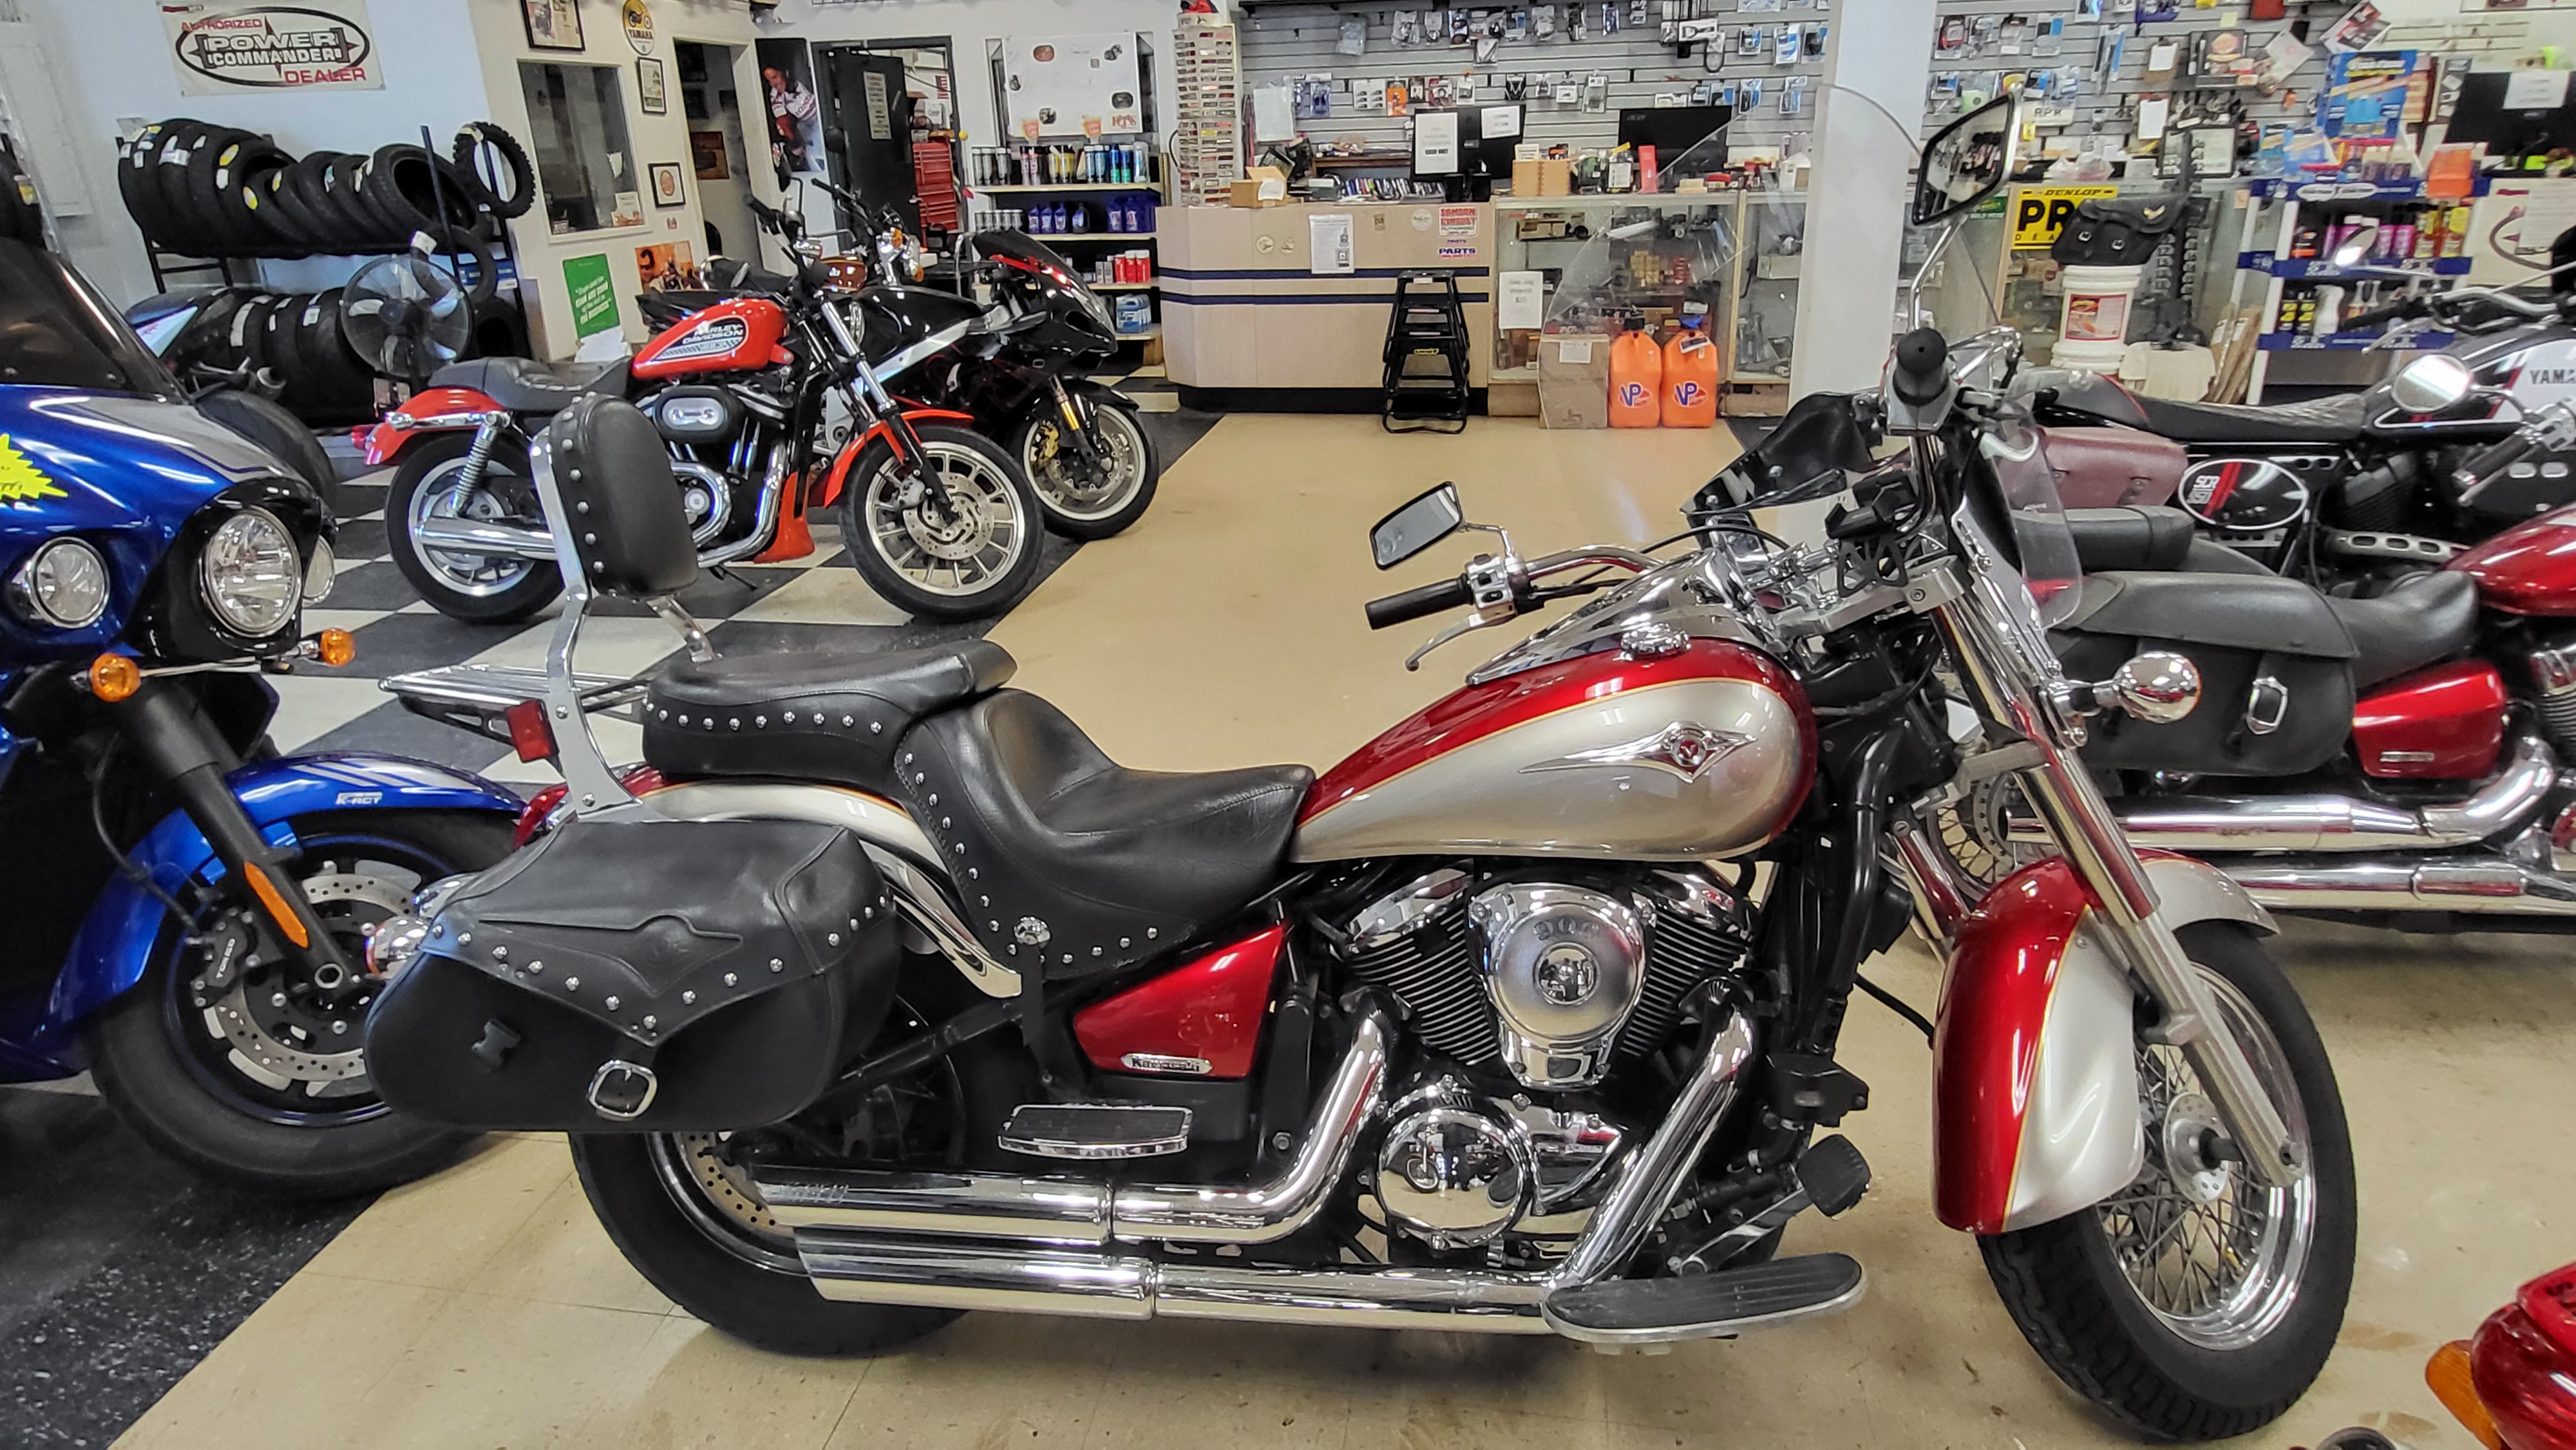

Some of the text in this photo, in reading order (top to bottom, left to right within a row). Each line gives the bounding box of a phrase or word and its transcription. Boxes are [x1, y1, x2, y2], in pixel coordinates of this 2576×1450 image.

[182, 19, 262, 32] AUTHORIZED
[207, 33, 336, 50] POWER
[628, 29, 654, 39] YAMAHA
[212, 48, 335, 67] COMMANDER
[284, 68, 366, 84] DEALER
[2034, 108, 2062, 117] RPM
[2017, 200, 2075, 231] PR
[682, 330, 743, 344] DAVIDSON
[1620, 384, 1642, 406] VP
[1676, 382, 1698, 406] VP
[2193, 475, 2220, 488] SCR
[336, 792, 383, 805] K-ACT
[1533, 917, 1599, 940] 900
[1132, 1057, 1200, 1072] Kawasaki
